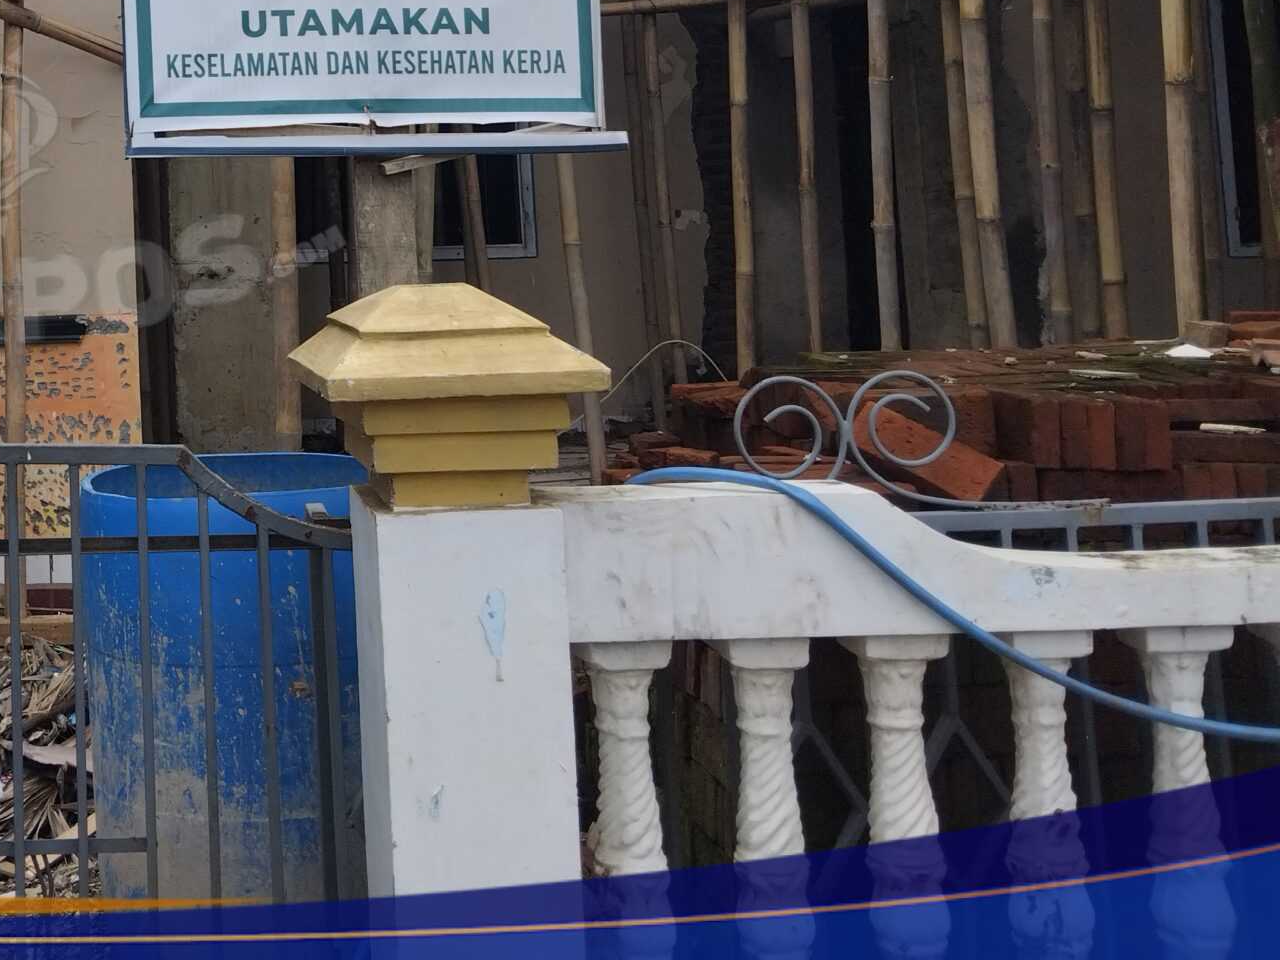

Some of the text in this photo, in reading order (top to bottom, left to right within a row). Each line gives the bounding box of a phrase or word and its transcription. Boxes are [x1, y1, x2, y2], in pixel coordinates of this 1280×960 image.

[241, 7, 491, 38] UTAMAKAN
[166, 49, 567, 79] KESELAMATAN DAN KESEHATAN KERJA
